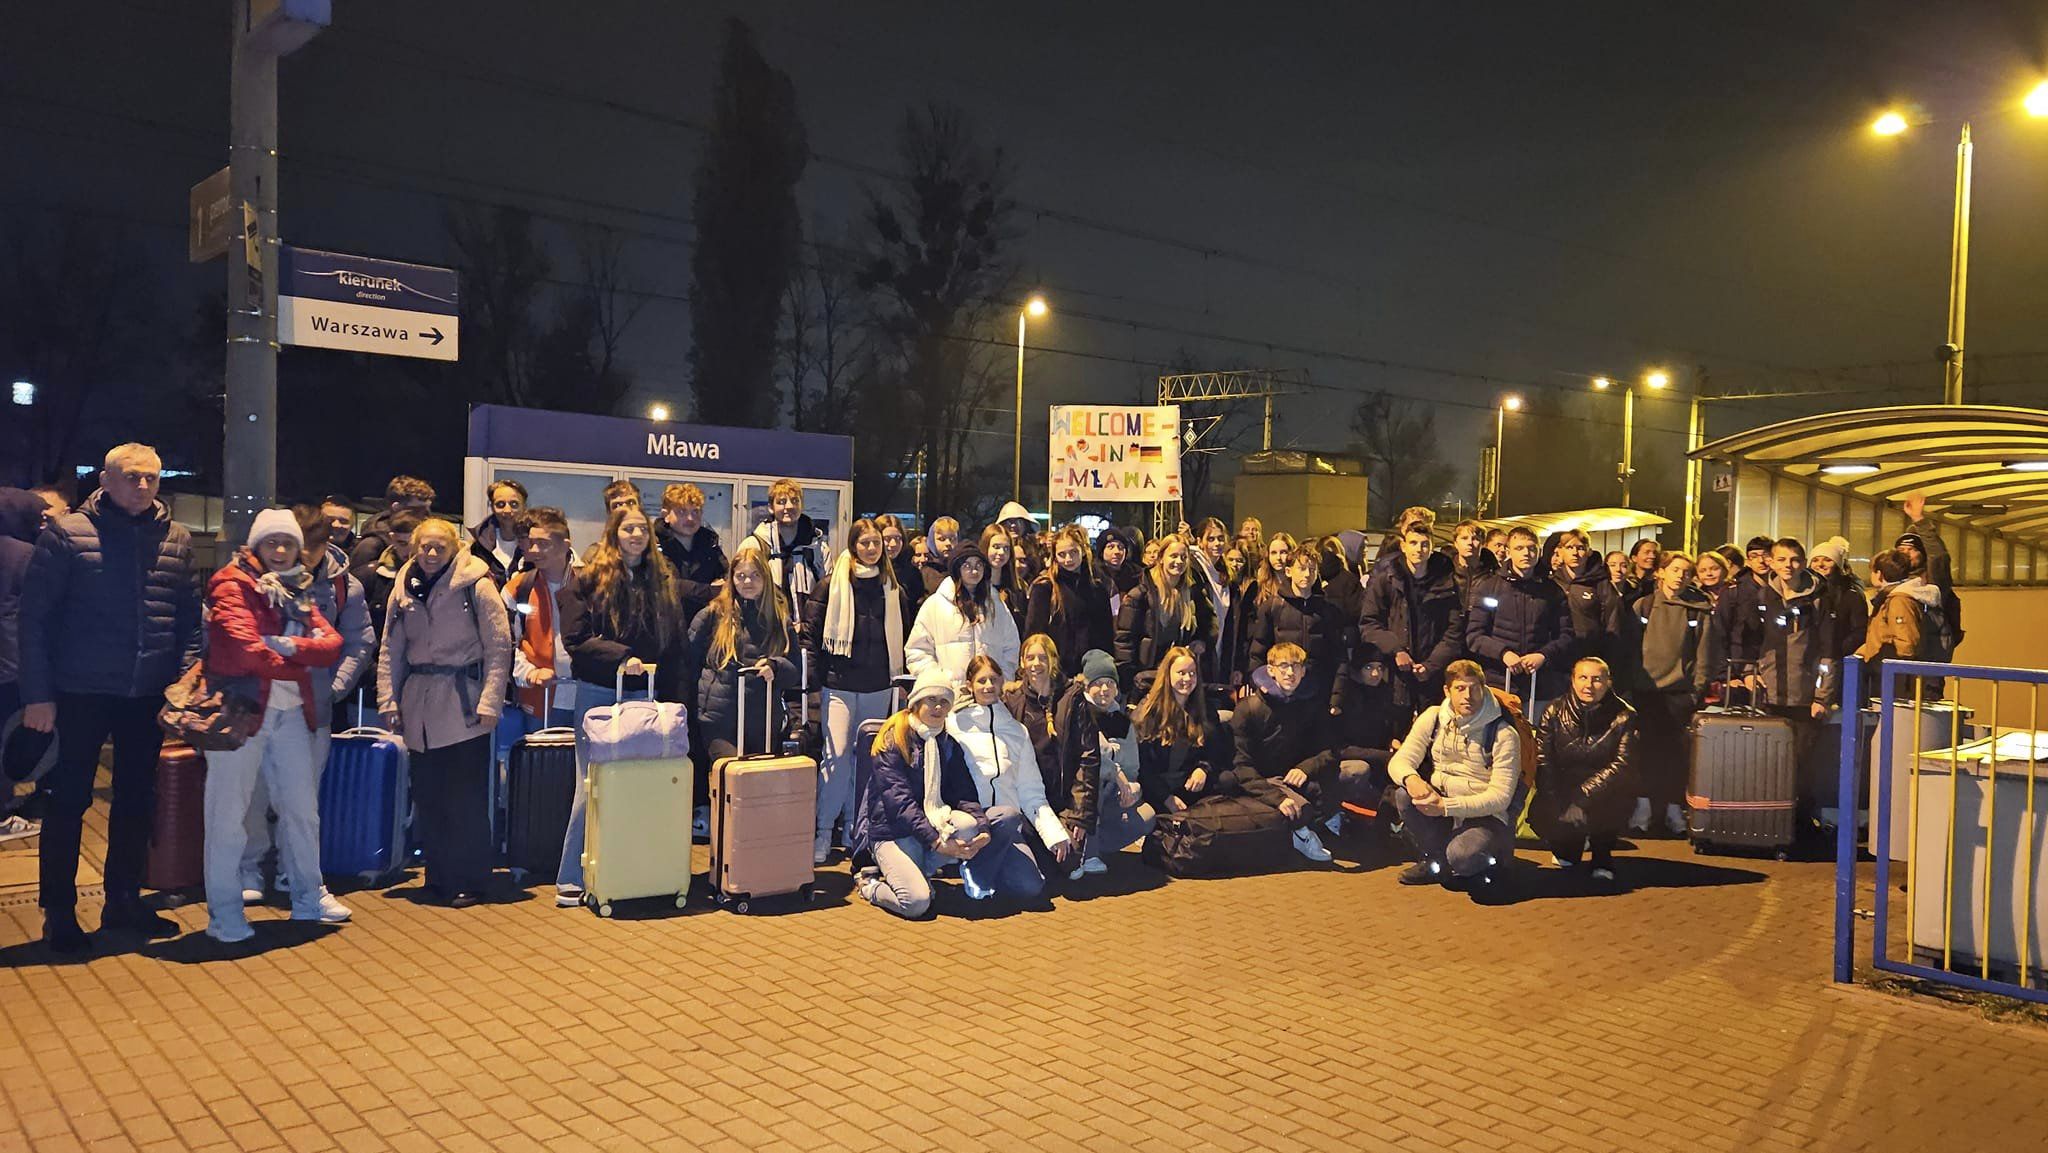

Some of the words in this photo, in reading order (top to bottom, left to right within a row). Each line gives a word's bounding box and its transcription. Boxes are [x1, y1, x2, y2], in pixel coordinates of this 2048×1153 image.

[338, 271, 402, 292] kierunek
[355, 290, 386, 301] direction
[311, 315, 409, 341] Warszawa
[1052, 411, 1155, 436] WELCOME
[647, 433, 719, 460] Mława
[1100, 443, 1124, 462] IN
